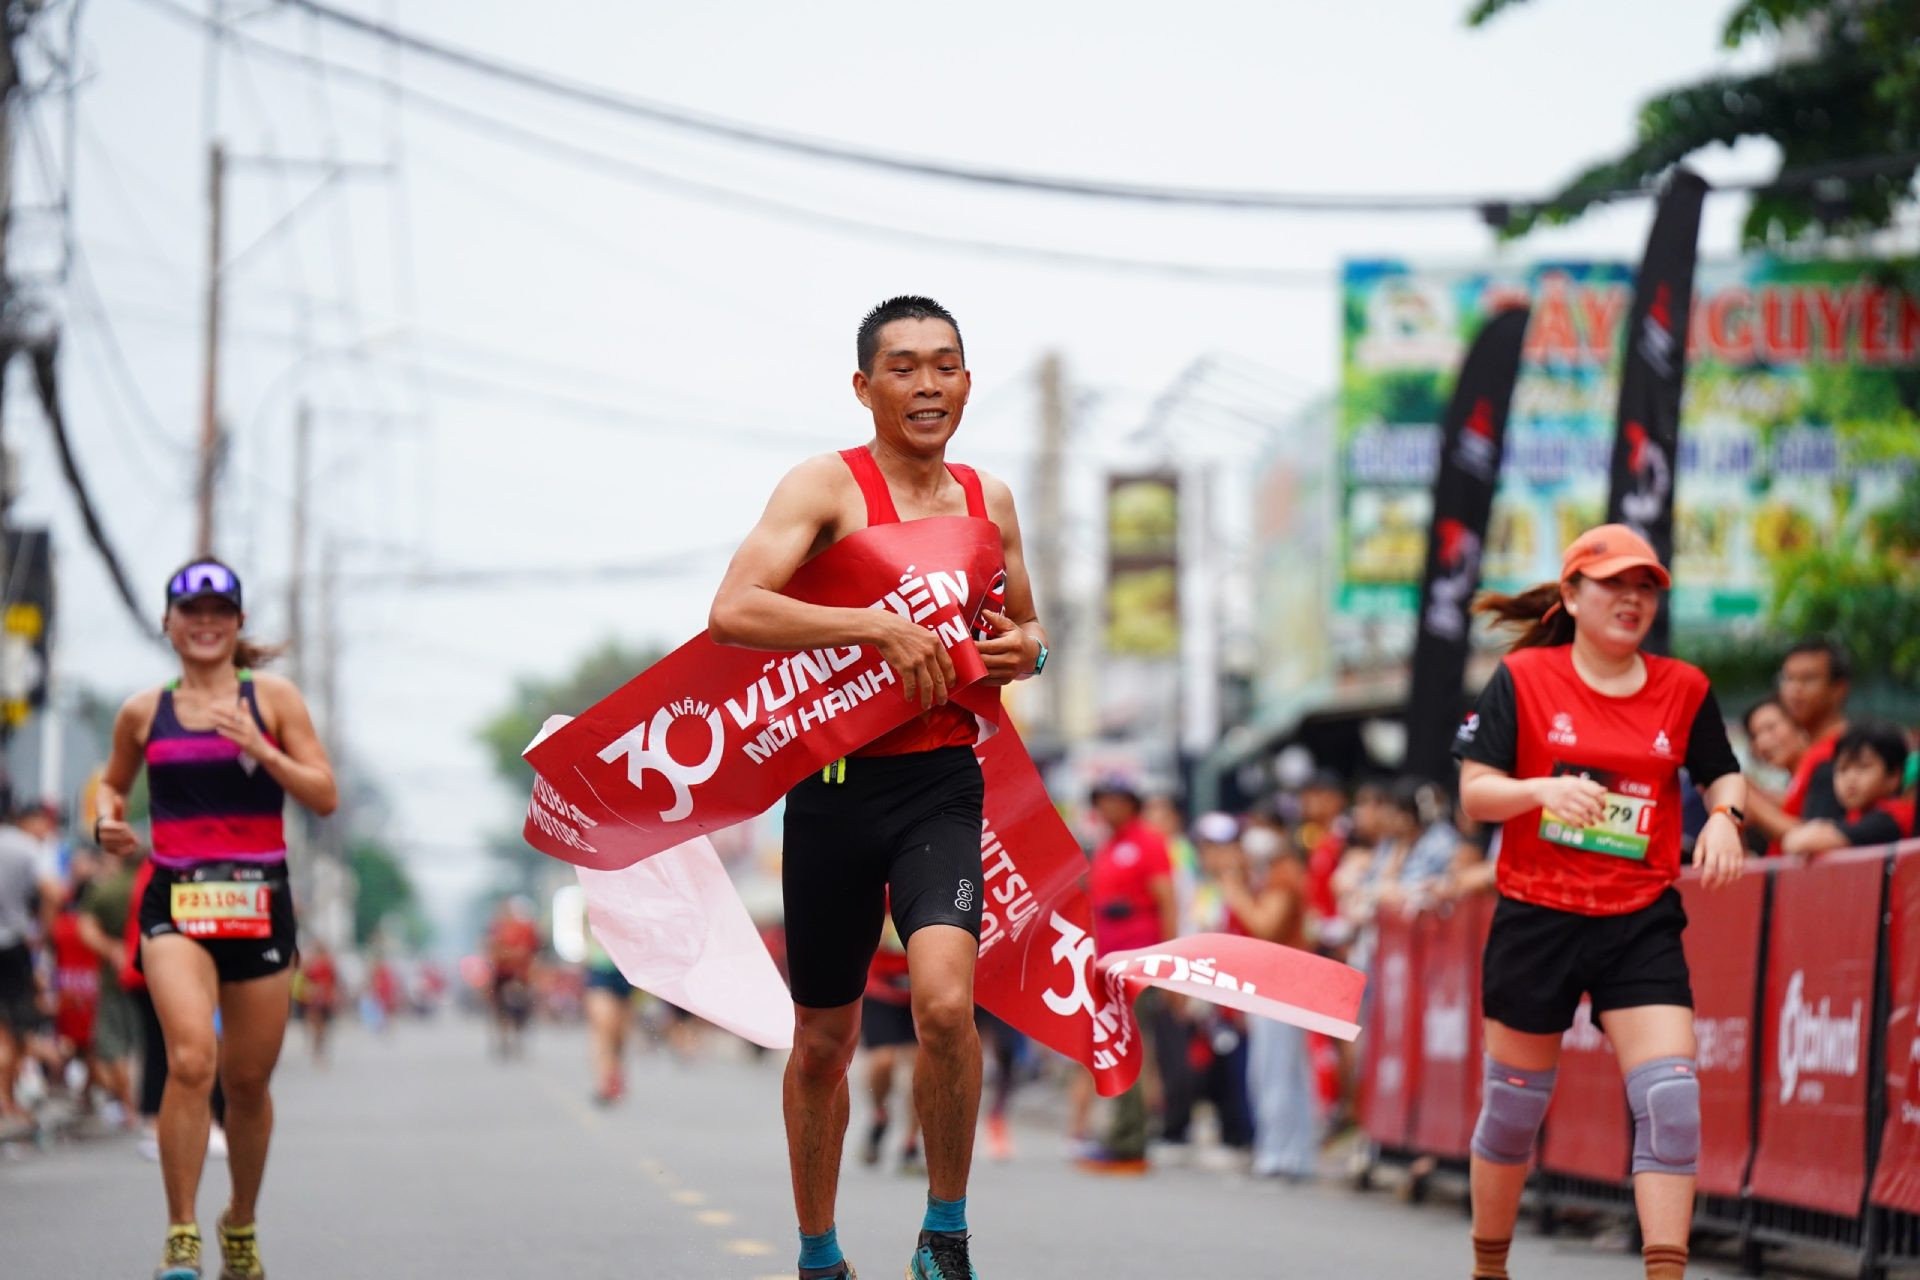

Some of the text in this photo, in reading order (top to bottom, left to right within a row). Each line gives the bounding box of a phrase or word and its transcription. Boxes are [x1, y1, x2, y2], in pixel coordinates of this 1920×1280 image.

[595, 705, 725, 823] 30
[742, 660, 896, 765] MỖI HÀNH
